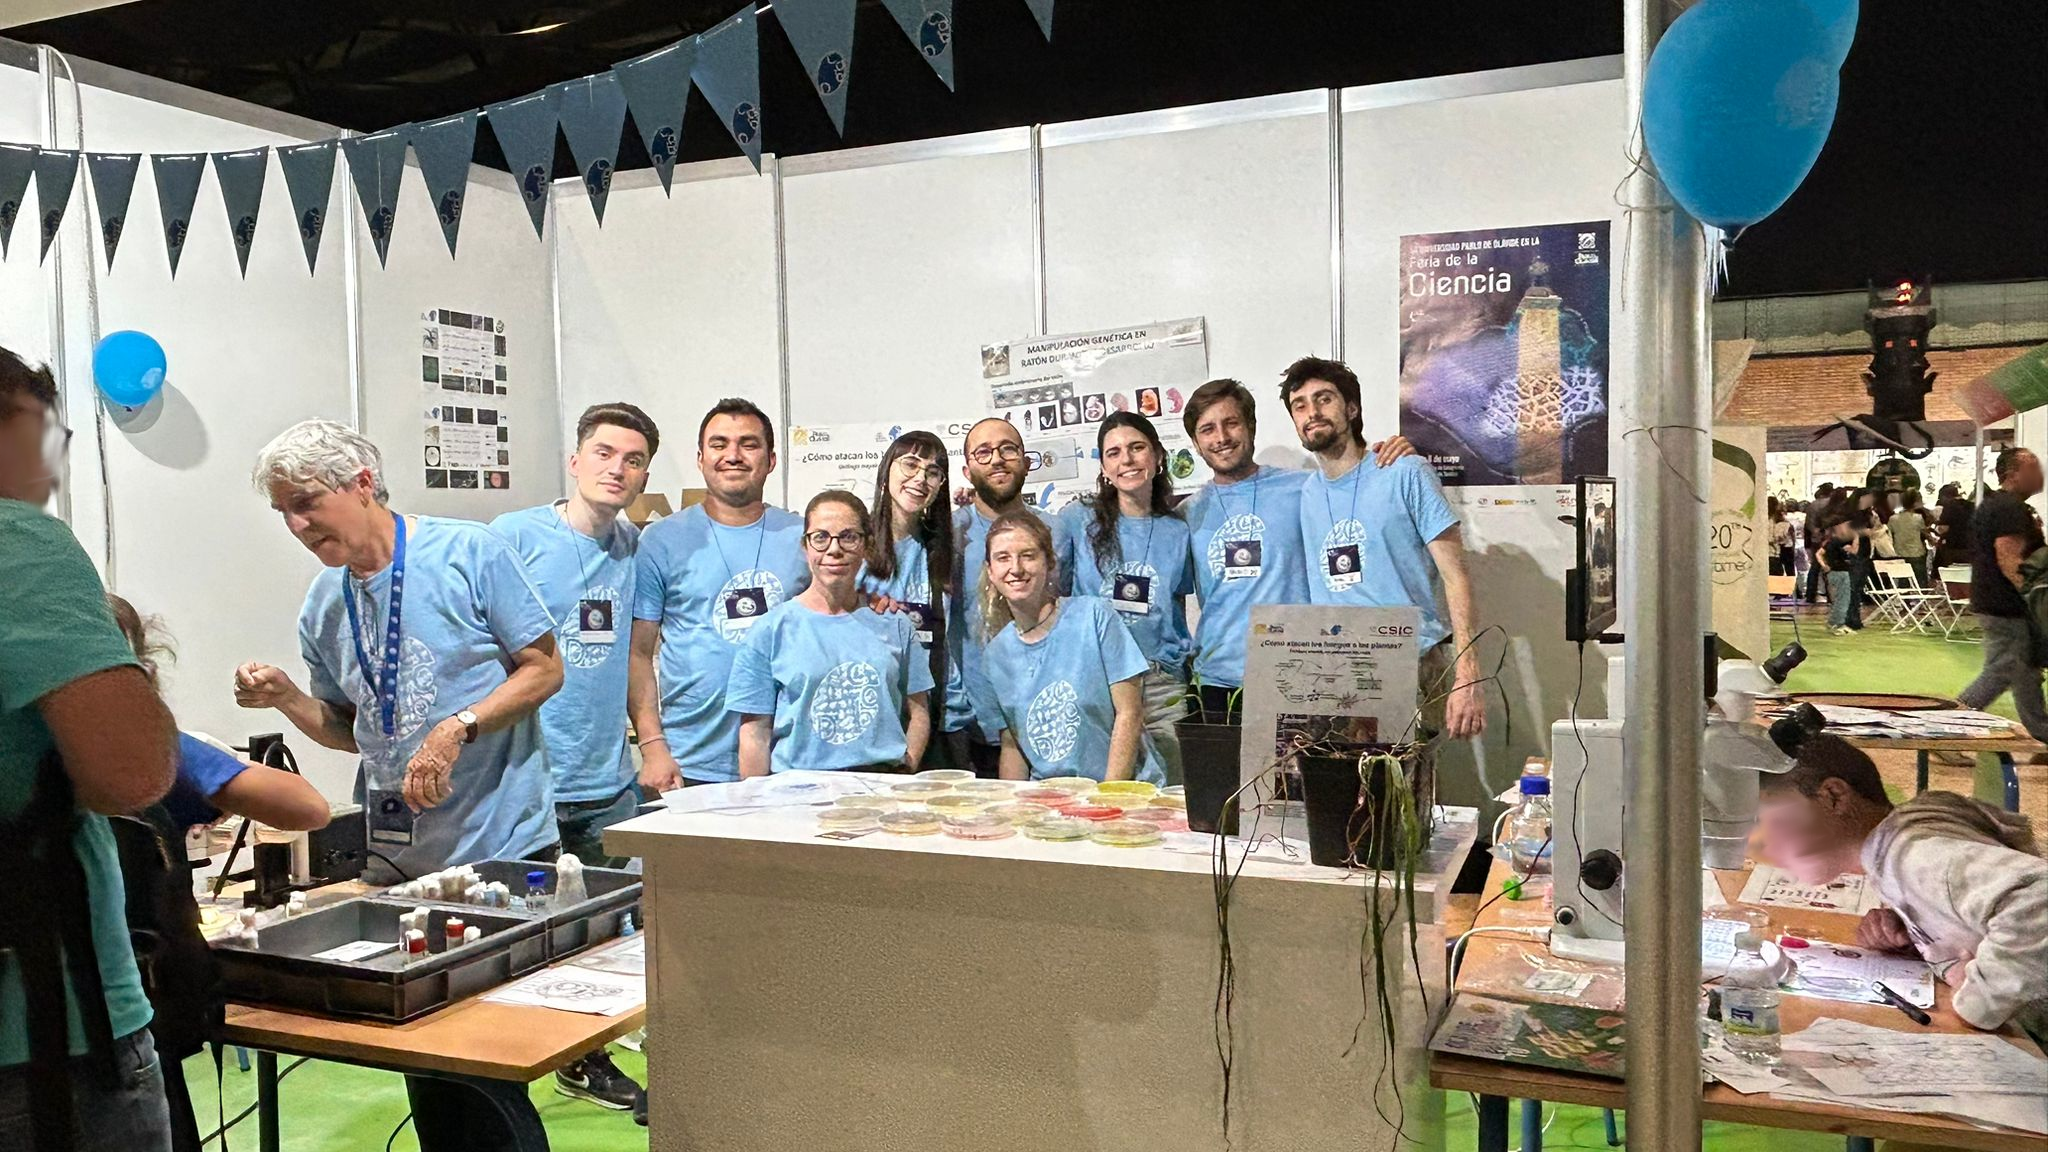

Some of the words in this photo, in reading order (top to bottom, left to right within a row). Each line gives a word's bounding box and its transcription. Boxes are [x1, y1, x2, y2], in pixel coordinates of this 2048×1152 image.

[1531, 236, 1540, 246] LA
[1409, 253, 1440, 269] Feria
[1445, 253, 1462, 266] de
[1467, 252, 1478, 266] la
[1409, 267, 1512, 297] Ciencia
[1027, 338, 1090, 354] MANIPULACIÓN
[1091, 331, 1133, 345] GENÉTICA
[1134, 330, 1147, 339] EN
[1020, 355, 1048, 368] RATÓN
[948, 423, 971, 436] CS
[802, 453, 833, 464] ¿Cómo
[835, 453, 863, 461] atacan
[865, 451, 879, 460] los
[1378, 625, 1413, 635] CSIC
